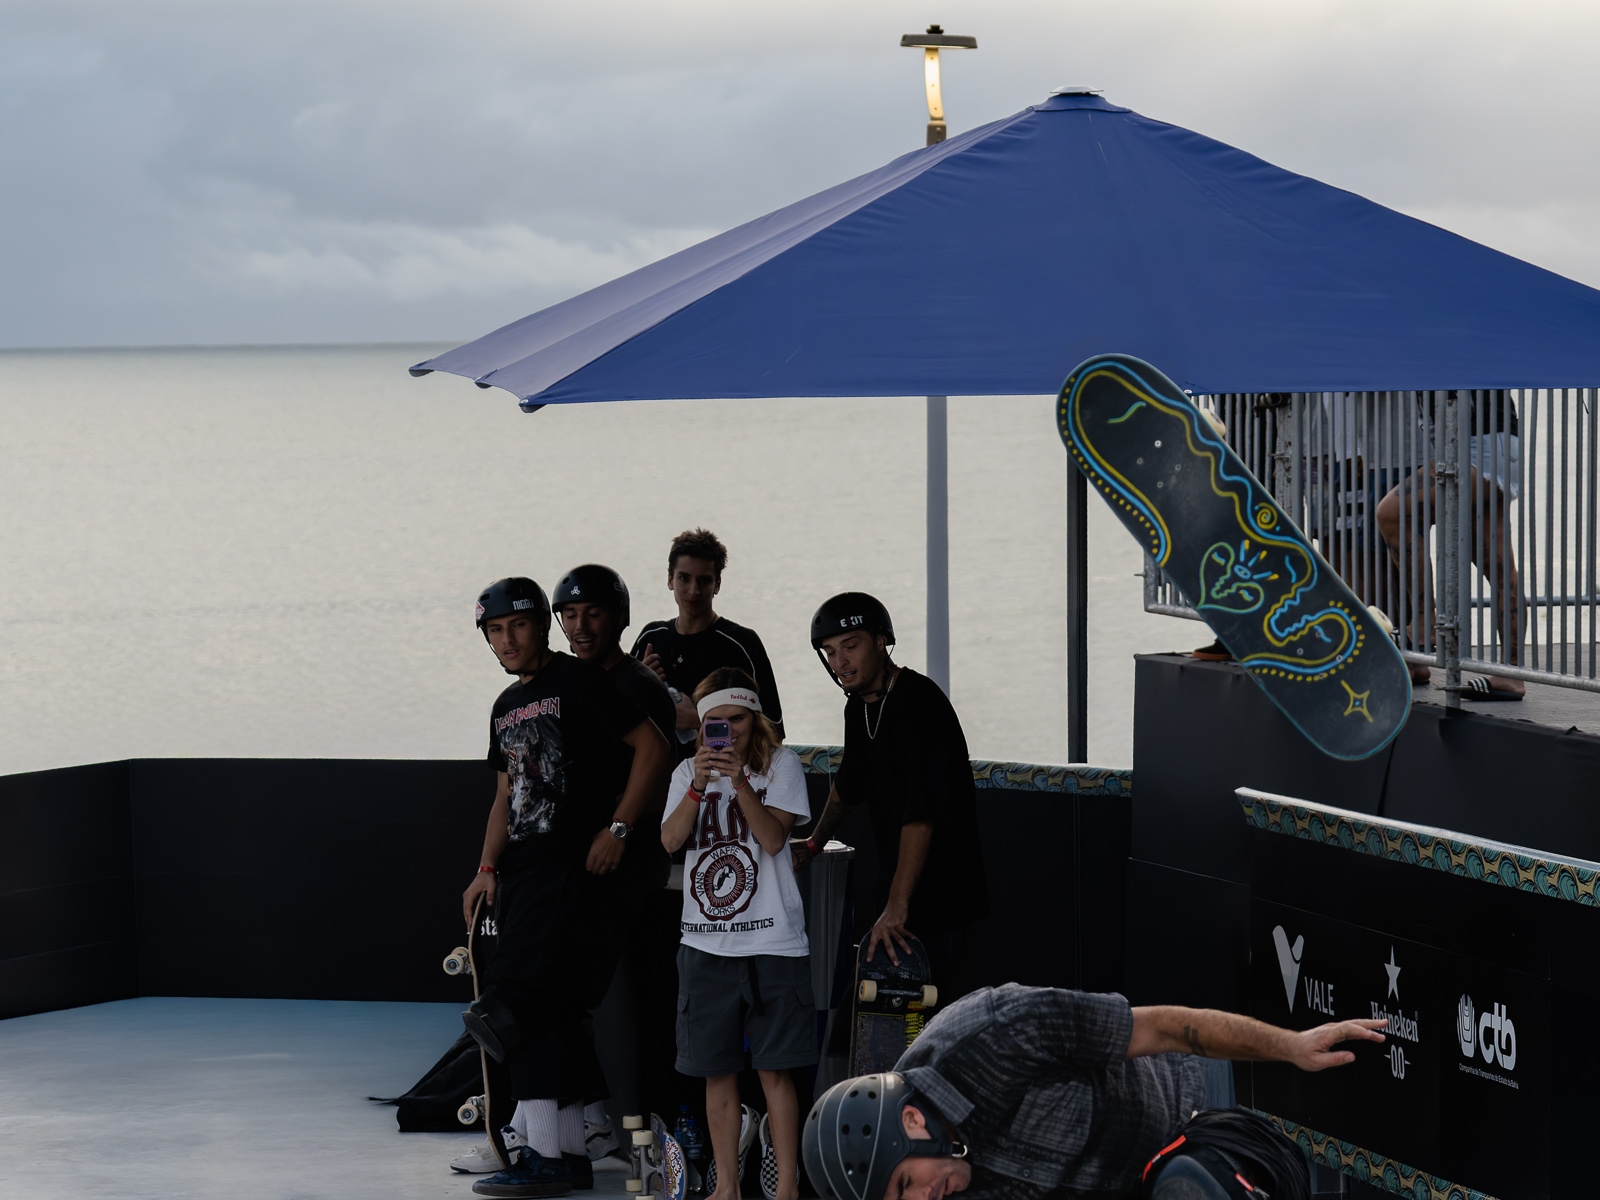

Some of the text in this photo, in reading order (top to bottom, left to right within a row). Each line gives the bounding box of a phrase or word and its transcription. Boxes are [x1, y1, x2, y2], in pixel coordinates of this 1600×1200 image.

[840, 615, 864, 628] EXIT
[515, 696, 560, 726] MAIDEN
[696, 871, 705, 897] VANS
[745, 865, 754, 892] VANS
[706, 903, 736, 916] WORKS
[730, 917, 774, 932] ATHLETICS
[1304, 976, 1335, 1016] VALE
[1478, 1001, 1517, 1071] ctb
